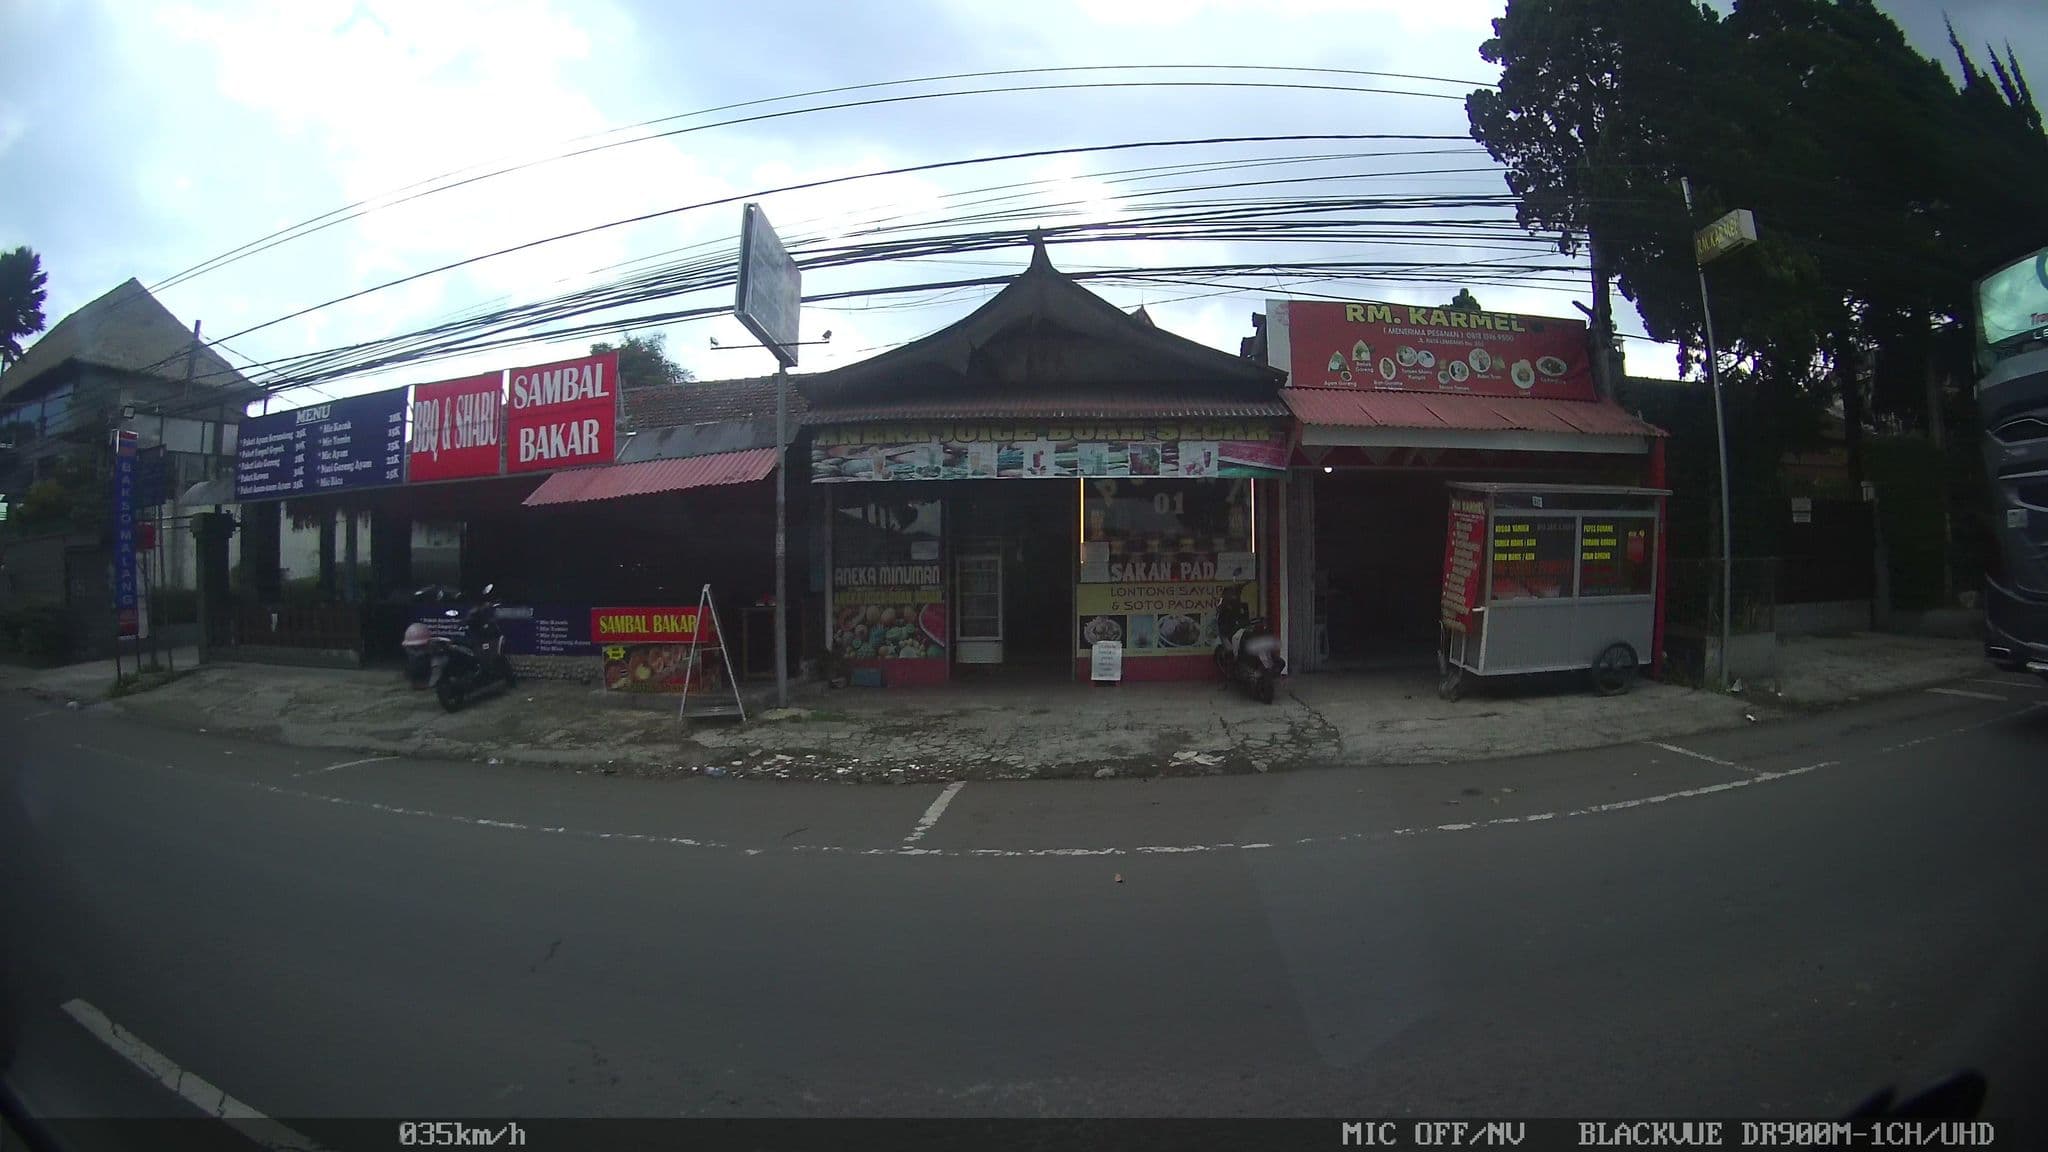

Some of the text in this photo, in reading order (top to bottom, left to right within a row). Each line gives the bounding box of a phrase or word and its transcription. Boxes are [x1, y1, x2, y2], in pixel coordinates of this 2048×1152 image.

[1346, 304, 1526, 332] RM. KARMEL
[1388, 328, 1426, 337] MENERIMA
[1427, 330, 1460, 338] PESANAN
[514, 363, 609, 410] SAMBAL
[296, 405, 331, 424] MENU
[412, 389, 499, 462] BBQ & SHABU
[519, 418, 600, 462] BAKAR
[334, 462, 354, 473] Goreng
[835, 565, 940, 585] ANEKA MINUMAN
[1111, 561, 1172, 582] SAKAN
[1180, 561, 1215, 581] PAD
[1111, 586, 1175, 598] LONTONG
[1112, 600, 1120, 611] &
[1123, 600, 1164, 611] SOTO
[600, 614, 698, 634] SAMBAL BAKAR
